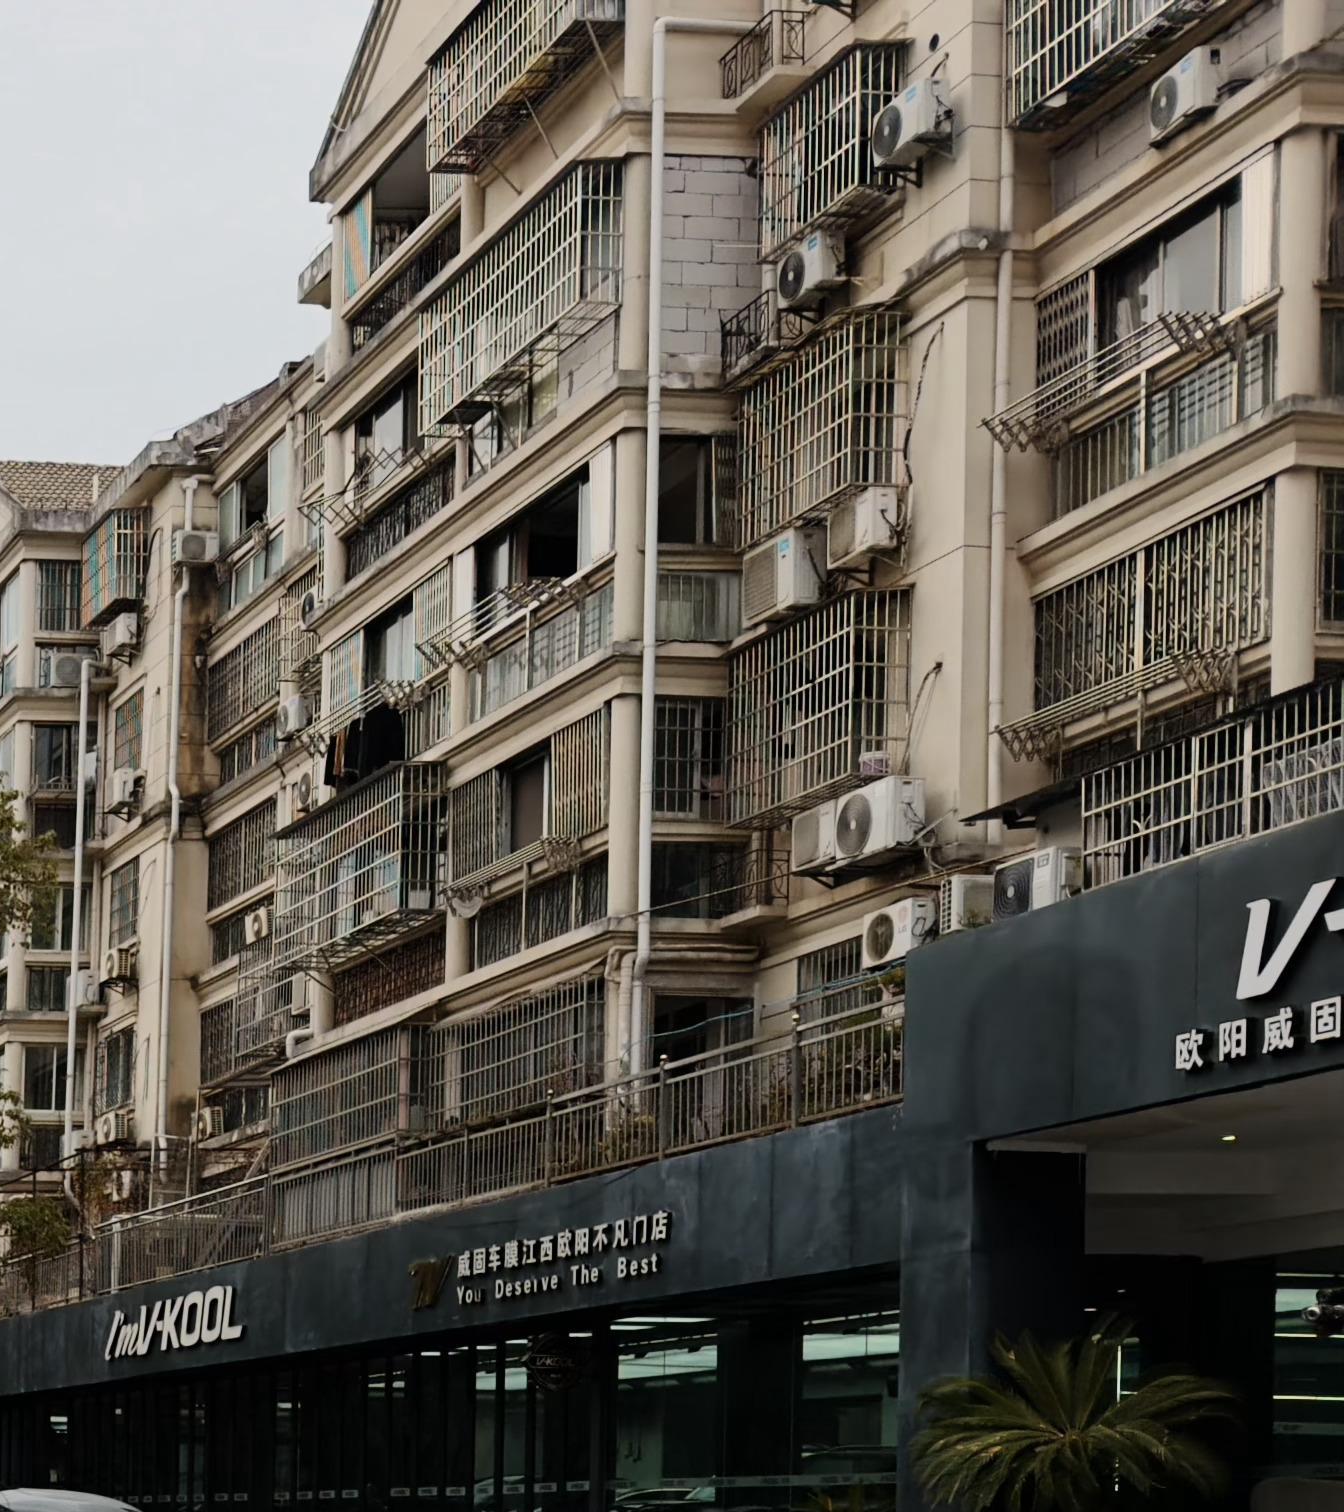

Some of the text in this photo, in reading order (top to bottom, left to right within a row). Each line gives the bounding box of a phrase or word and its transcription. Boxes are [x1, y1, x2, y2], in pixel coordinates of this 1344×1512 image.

[1175, 996, 1342, 1070] 欧阳威固
[456, 1285, 482, 1305] You
[571, 1264, 599, 1285] The
[617, 1253, 658, 1279] Best
[457, 1210, 670, 1279] 威固车膜江西欧阳不凡门店
